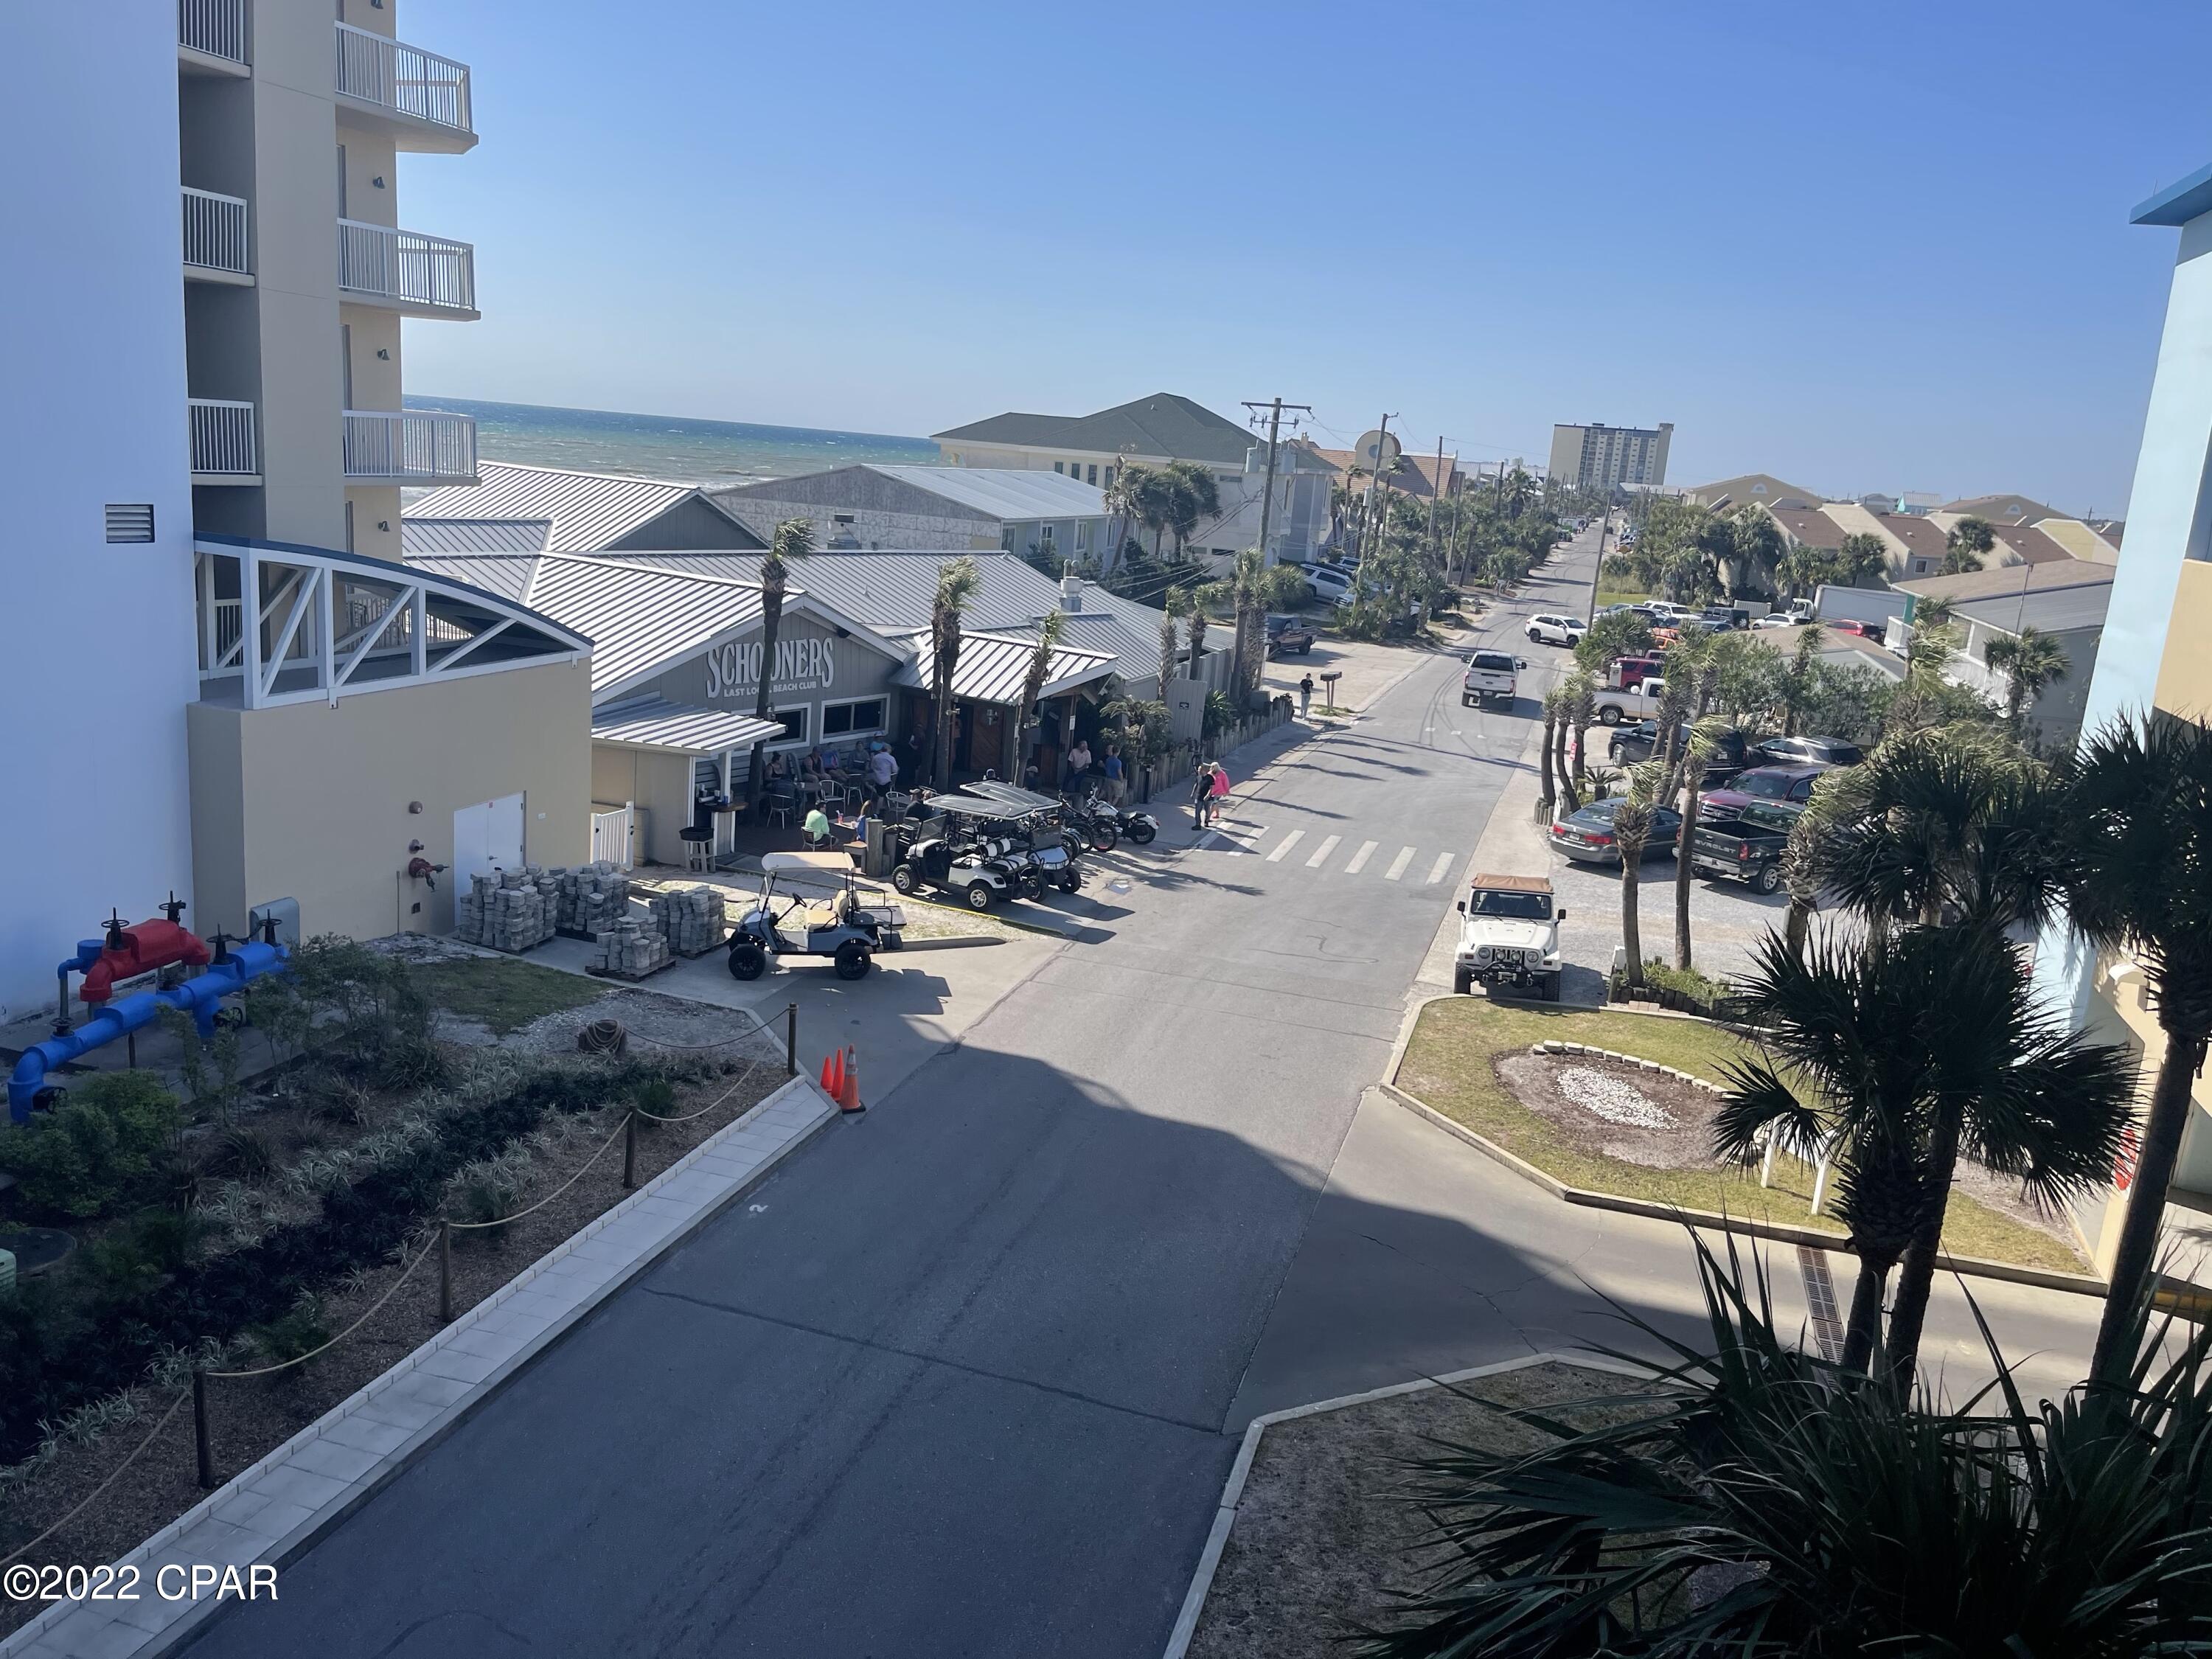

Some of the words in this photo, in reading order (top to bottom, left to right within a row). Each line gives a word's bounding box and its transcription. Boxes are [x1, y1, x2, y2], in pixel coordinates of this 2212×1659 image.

[723, 687, 745, 698] LAST
[773, 682, 798, 692] BEACH
[799, 681, 817, 690] CLUB
[1694, 839, 1736, 854] EVROLET
